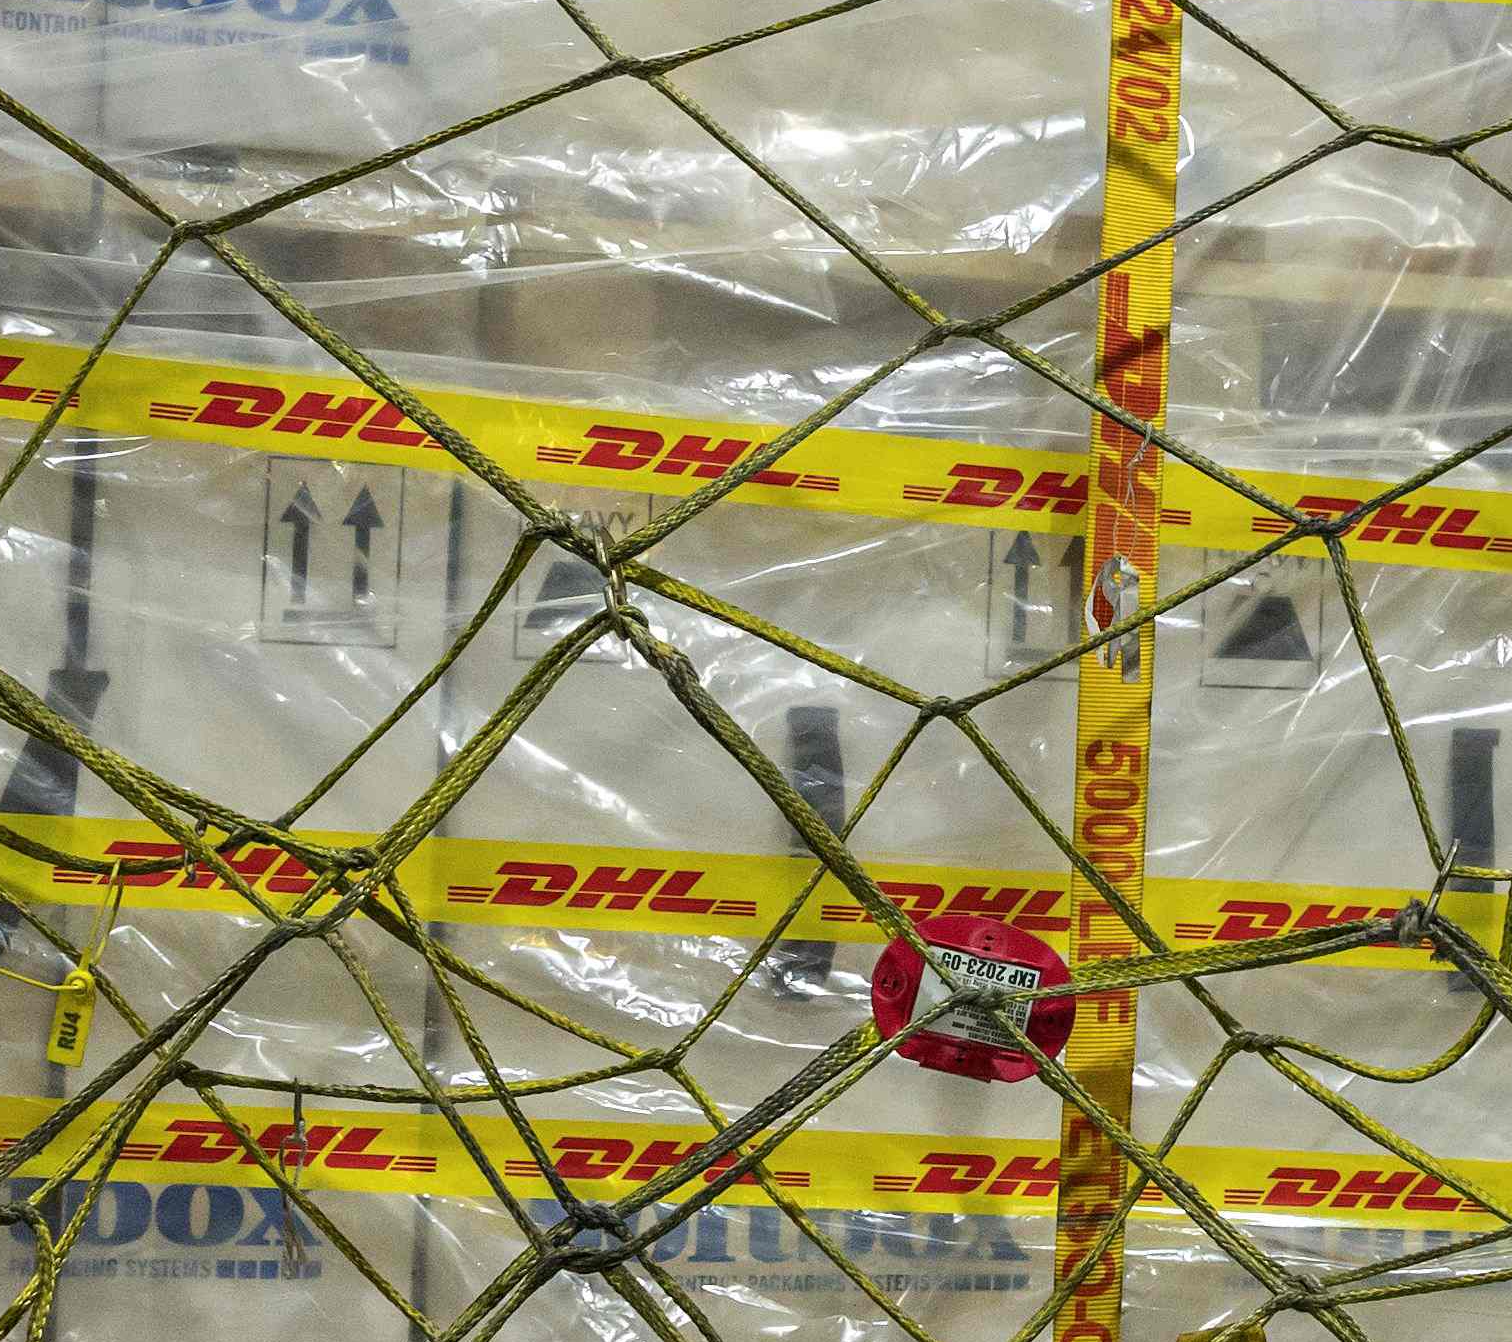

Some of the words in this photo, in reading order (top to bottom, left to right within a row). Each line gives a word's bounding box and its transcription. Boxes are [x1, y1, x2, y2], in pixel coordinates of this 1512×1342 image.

[196, 382, 432, 445] DHL
[945, 465, 1087, 513] DH
[1081, 738, 1142, 884] 5000
[494, 863, 713, 913] DHL
[941, 951, 1008, 982] 2023-05
[1008, 967, 1037, 989] EXP
[56, 1011, 81, 1050] RU4
[162, 1121, 391, 1168] DHL
[916, 1155, 1059, 1195] DH
[1265, 1169, 1459, 1210] DHL
[125, 1259, 213, 1279] SYSTEMS
